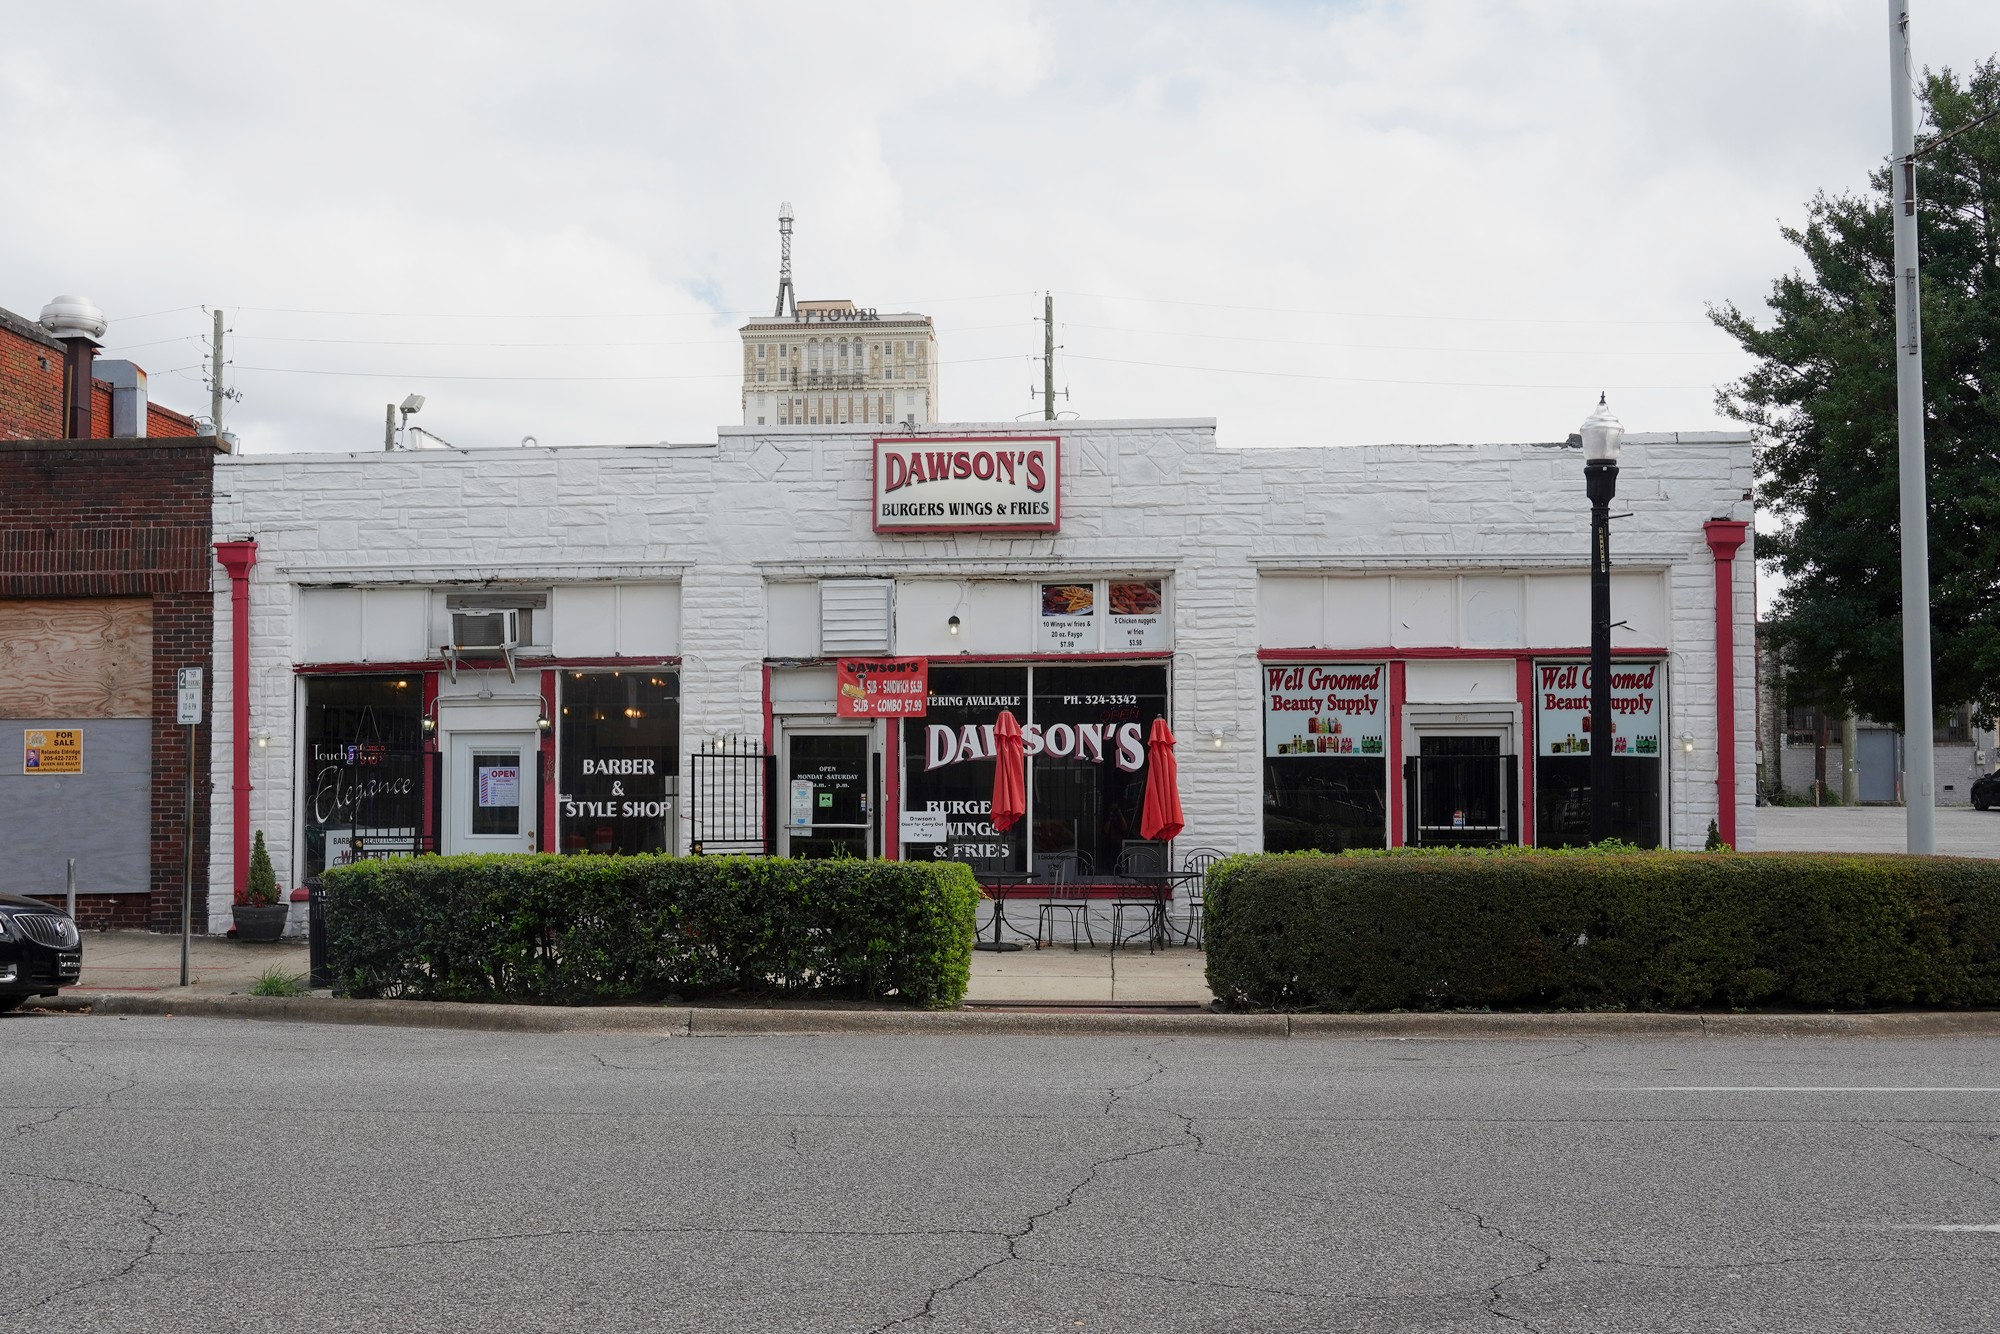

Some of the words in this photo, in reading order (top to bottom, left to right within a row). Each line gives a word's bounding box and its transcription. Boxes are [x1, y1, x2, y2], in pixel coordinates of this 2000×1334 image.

[816, 308, 880, 321] TOWER
[885, 450, 1046, 494] DAWSON'S
[882, 503, 945, 516] BURGERS
[949, 502, 993, 515] WINGS
[996, 503, 1007, 515] &
[1010, 501, 1050, 515] FRIES
[1050, 621, 1066, 629] Wings
[1138, 617, 1157, 626] nuggets
[1067, 631, 1083, 639] Faygo
[847, 662, 919, 673] DAWSON'S
[180, 671, 185, 686] 2
[1267, 667, 1304, 691] Well
[1308, 666, 1381, 691] Groomed
[1541, 666, 1578, 690] Well
[1582, 665, 1655, 690] Gomed
[867, 680, 877, 694] SUB
[883, 680, 909, 694] SANDWICH
[853, 699, 869, 712] SUB
[877, 699, 902, 712] COMBO
[904, 699, 922, 712] $7.99
[926, 696, 963, 706] TERING
[966, 696, 1020, 706] AVAILABLE
[1063, 695, 1082, 705] PH.
[1085, 695, 1137, 705] 324-3342
[1271, 695, 1323, 715] Beauty
[1327, 693, 1379, 715] Supply
[1611, 693, 1653, 715] upply
[1100, 707, 1141, 722] OPEN
[312, 743, 347, 760] Touch
[491, 770, 516, 778] OPEN
[582, 759, 655, 775] BARBER
[314, 765, 415, 824] Elegance
[611, 780, 625, 796] &
[565, 801, 617, 818] STYLE
[622, 801, 672, 818] SHOP
[926, 800, 992, 815] BURGE
[933, 845, 948, 858] &
[953, 843, 1010, 858] FRIES
